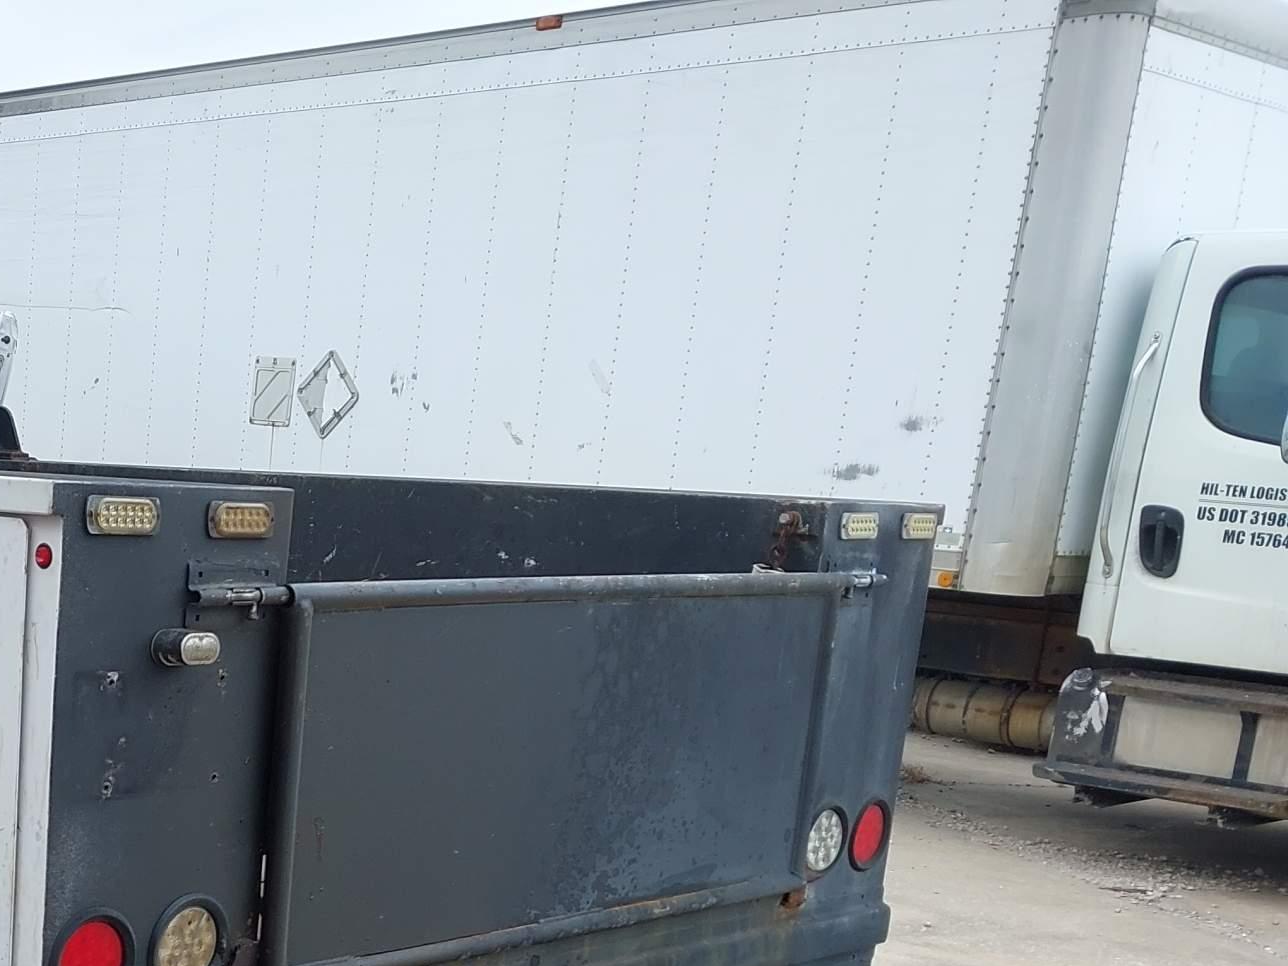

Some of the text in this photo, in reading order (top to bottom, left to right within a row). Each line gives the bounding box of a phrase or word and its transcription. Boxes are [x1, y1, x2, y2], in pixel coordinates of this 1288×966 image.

[1200, 482, 1248, 498] HIL-TEN
[1197, 506, 1288, 527] US DOT 3198
[1222, 529, 1246, 544] MC
